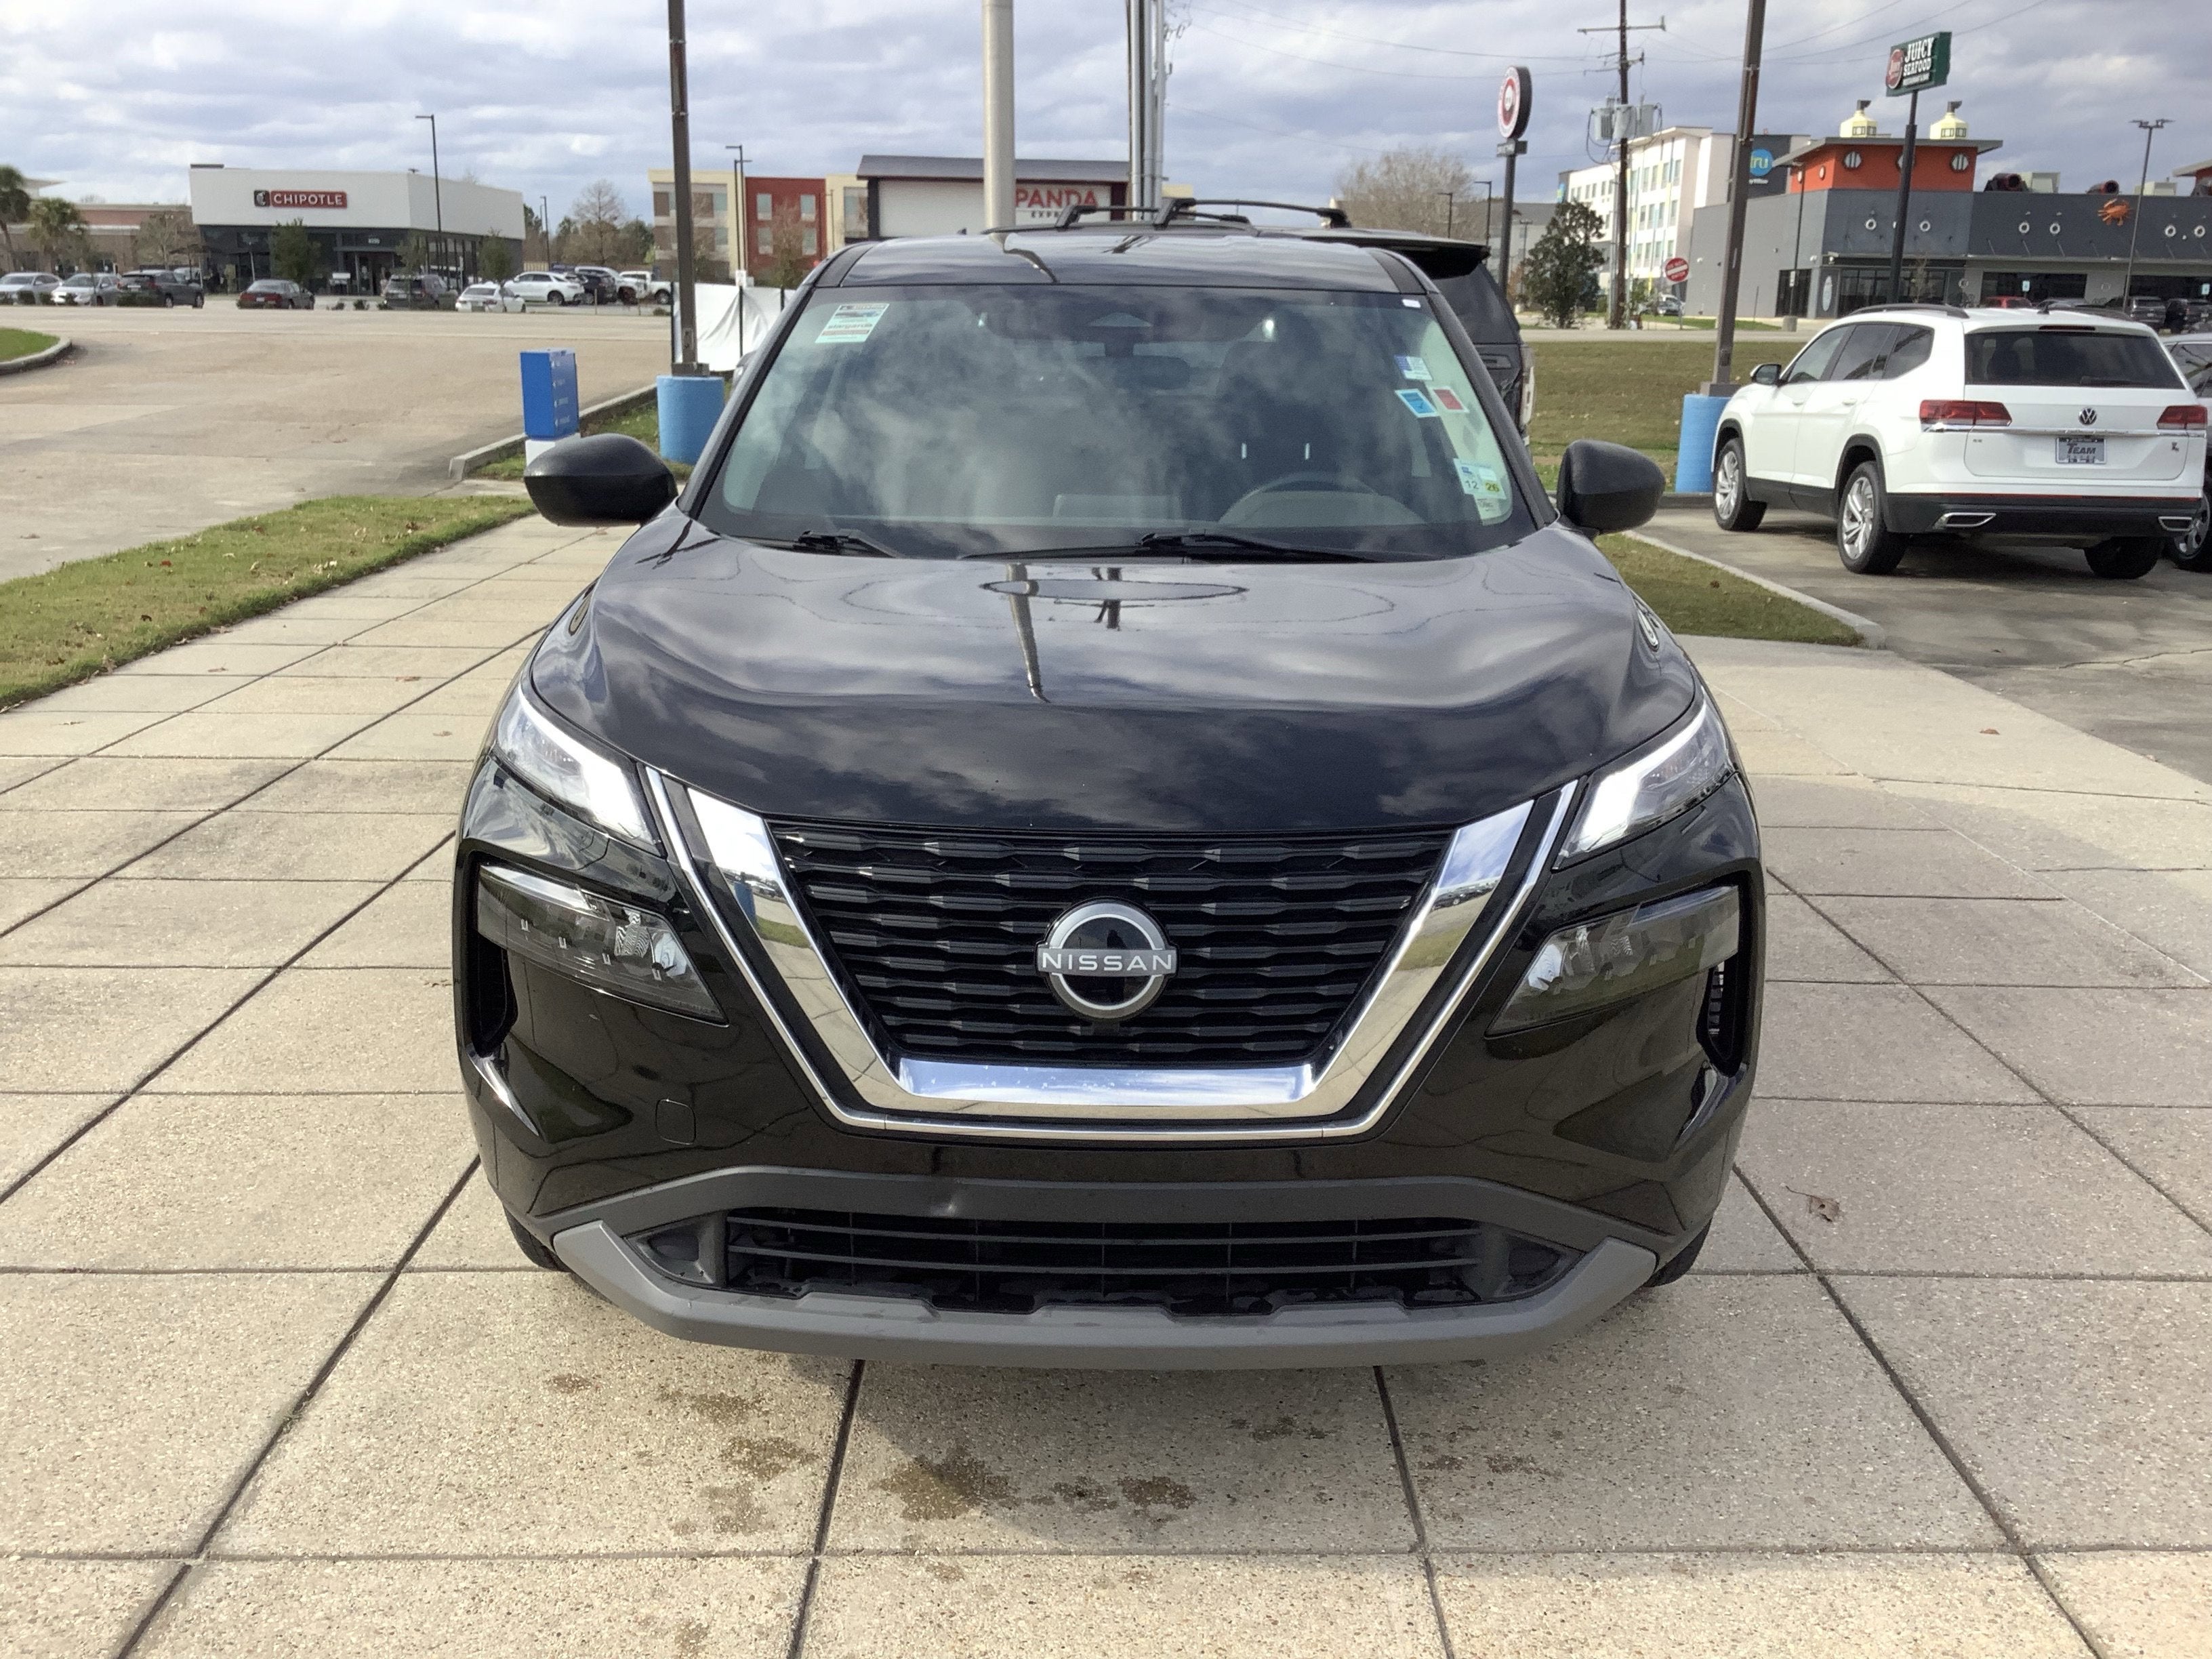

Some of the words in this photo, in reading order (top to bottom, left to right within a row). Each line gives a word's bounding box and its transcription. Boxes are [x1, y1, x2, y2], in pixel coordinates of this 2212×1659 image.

[1904, 37, 1934, 63] JUICY
[1903, 58, 1931, 77] SEAFOOD
[273, 193, 343, 205] CHIPOTLE
[1016, 188, 1098, 208] PANDA
[2066, 443, 2097, 455] TEAM
[1465, 480, 1479, 490] 12
[1485, 482, 1500, 493] 26
[1042, 951, 1172, 972] NISSAN
